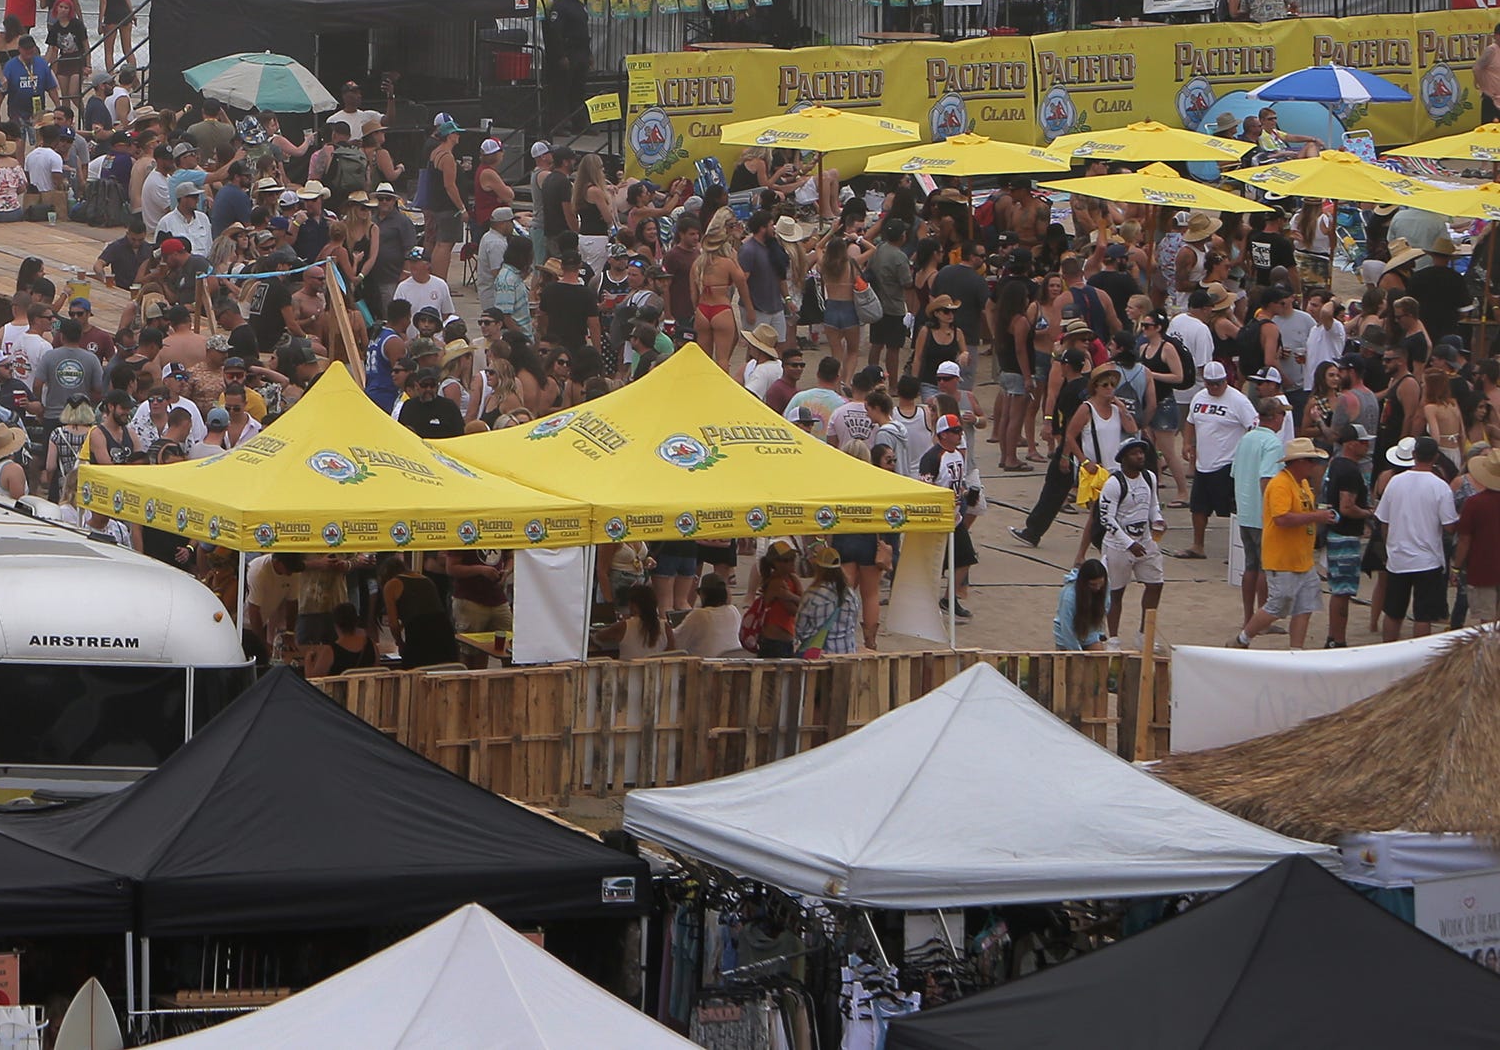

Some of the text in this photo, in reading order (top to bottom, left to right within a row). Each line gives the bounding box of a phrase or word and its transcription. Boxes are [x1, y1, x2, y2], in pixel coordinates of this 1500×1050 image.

[1313, 35, 1413, 67] PACIFICO
[1174, 42, 1276, 81] PACIFICO
[1038, 51, 1137, 91] PACIFICO
[927, 58, 1028, 98] PACIFICO
[778, 65, 886, 106] PACIFICO
[1093, 98, 1134, 113] CLARA
[981, 106, 1026, 121] CLARA
[699, 425, 796, 446] PACIFICO
[572, 439, 602, 461] CLARA
[755, 445, 802, 455] CLARA
[348, 447, 436, 477] PACIFICO
[402, 472, 444, 487] CLARA
[696, 510, 733, 521] PACIFICO
[766, 505, 804, 517] PACIFICO
[835, 505, 873, 516] PACIFICO
[904, 504, 941, 516] PACIFICO
[342, 520, 379, 533] PACIFICO
[410, 520, 447, 533] PACIFICO
[478, 519, 513, 530] PACIFICO
[545, 517, 580, 529] PACIFICO
[626, 514, 663, 527] PACIFICO
[274, 521, 311, 534] PACIFICO
[29, 635, 139, 648] AIRSTREAM
